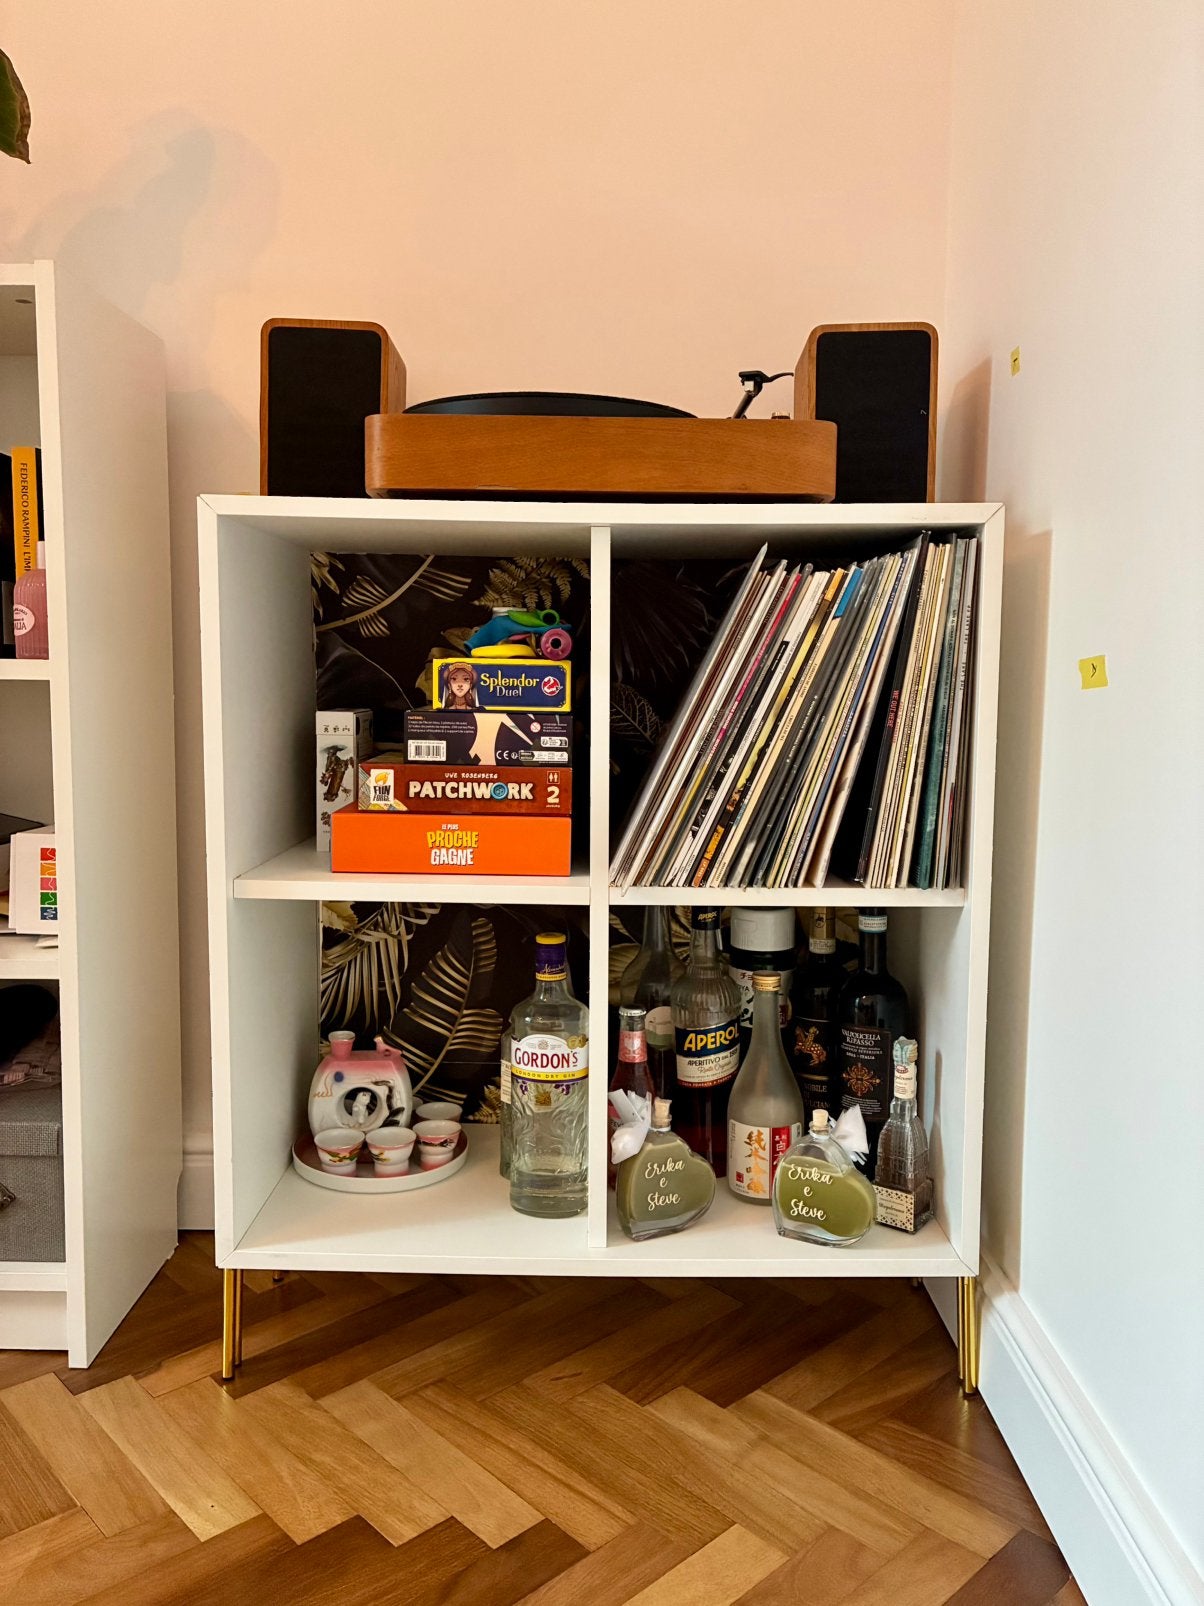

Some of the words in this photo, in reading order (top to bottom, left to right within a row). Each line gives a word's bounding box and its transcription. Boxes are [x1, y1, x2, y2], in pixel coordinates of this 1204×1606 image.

[19, 462, 30, 508] FEDERICO
[22, 509, 31, 548] RAMPINI
[480, 670, 540, 693] Splendor
[496, 686, 522, 697] Duel
[892, 689, 899, 699] WE
[889, 699, 897, 711] OUT
[886, 711, 895, 728] HERE
[373, 785, 391, 796] FUN
[408, 780, 534, 801] PATCHWORK
[546, 785, 560, 804] 2
[426, 830, 479, 848] PROCHE
[430, 848, 474, 866] GAGNE
[683, 1022, 740, 1052] APEROL
[841, 1028, 881, 1041] VALPOLICELLA
[846, 1036, 875, 1047] RIPASSO
[514, 1047, 579, 1069] GORDON'S
[687, 1056, 721, 1067] APERITIVO
[515, 1069, 542, 1079] LONDON
[644, 1157, 686, 1179] Erika
[788, 1163, 833, 1185] Erika
[659, 1177, 668, 1188] e
[803, 1186, 814, 1197] e
[647, 1191, 681, 1211] Steve
[790, 1198, 827, 1221] Steve
